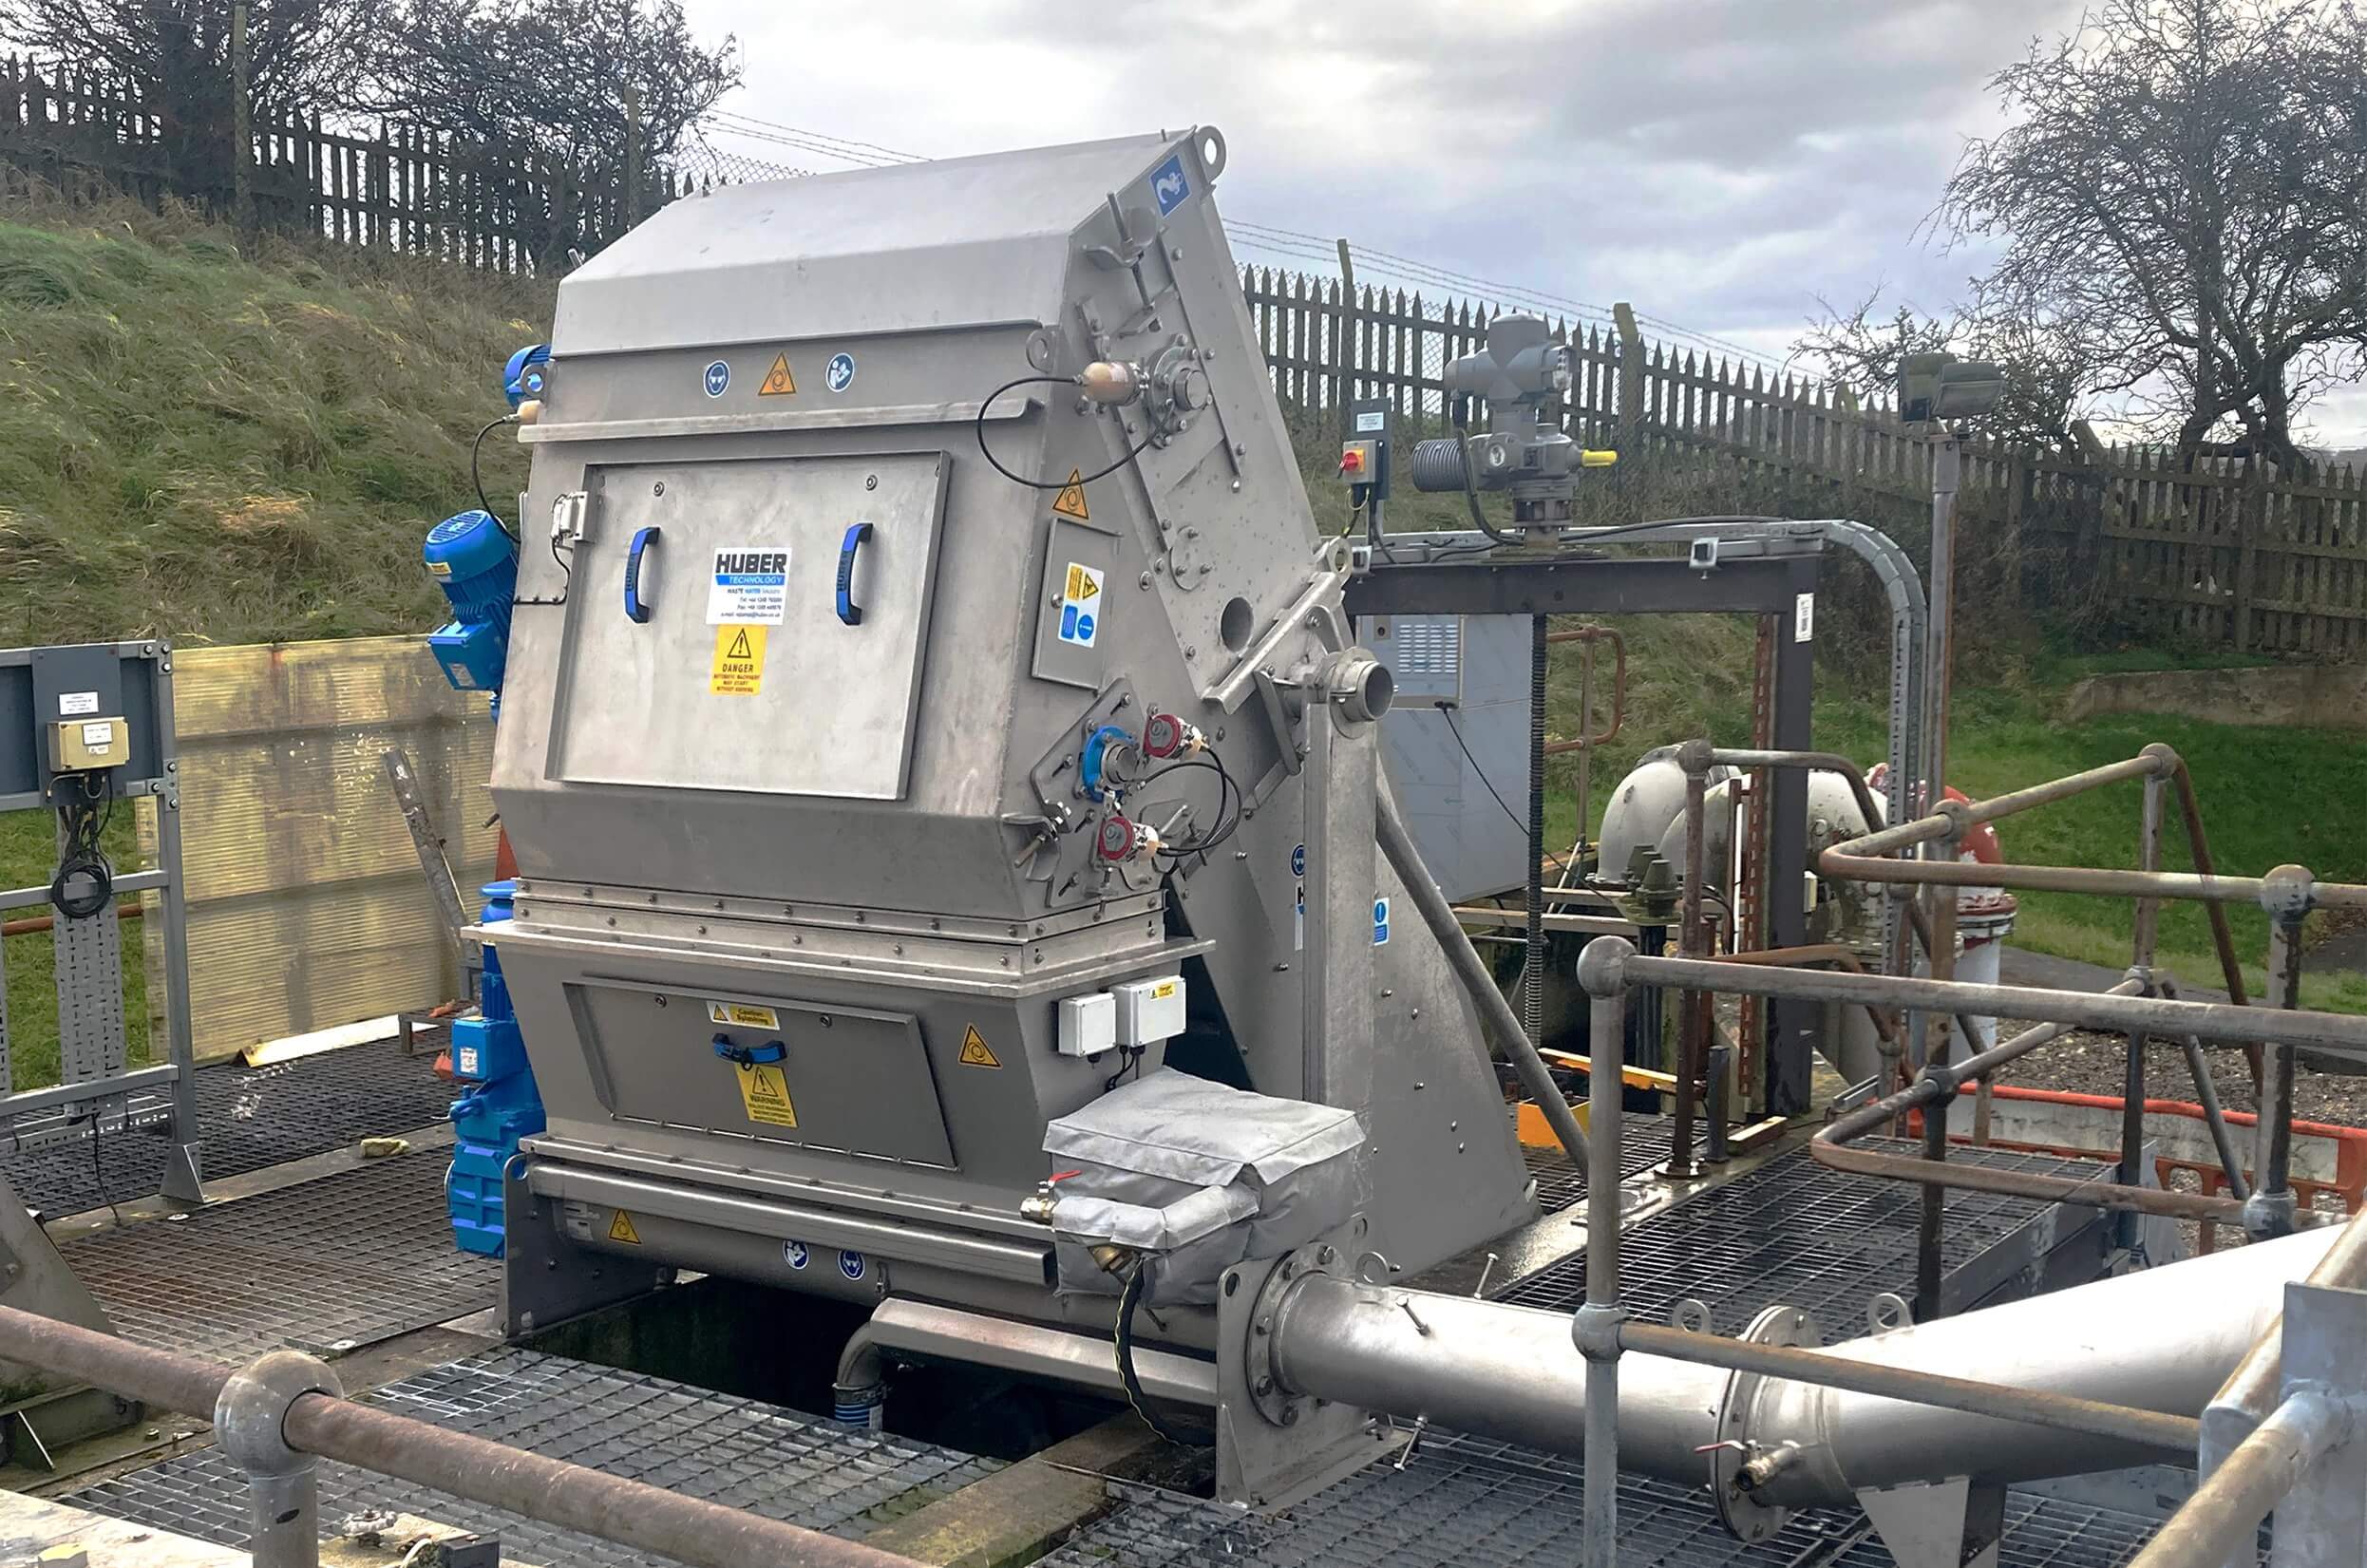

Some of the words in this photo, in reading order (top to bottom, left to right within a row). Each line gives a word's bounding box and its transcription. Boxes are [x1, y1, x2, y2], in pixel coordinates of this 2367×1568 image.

[715, 553, 787, 574] HUBER
[729, 576, 783, 584] TECHNOLOGY
[722, 663, 754, 673] DANGER
[748, 1093, 786, 1107] WARNING
